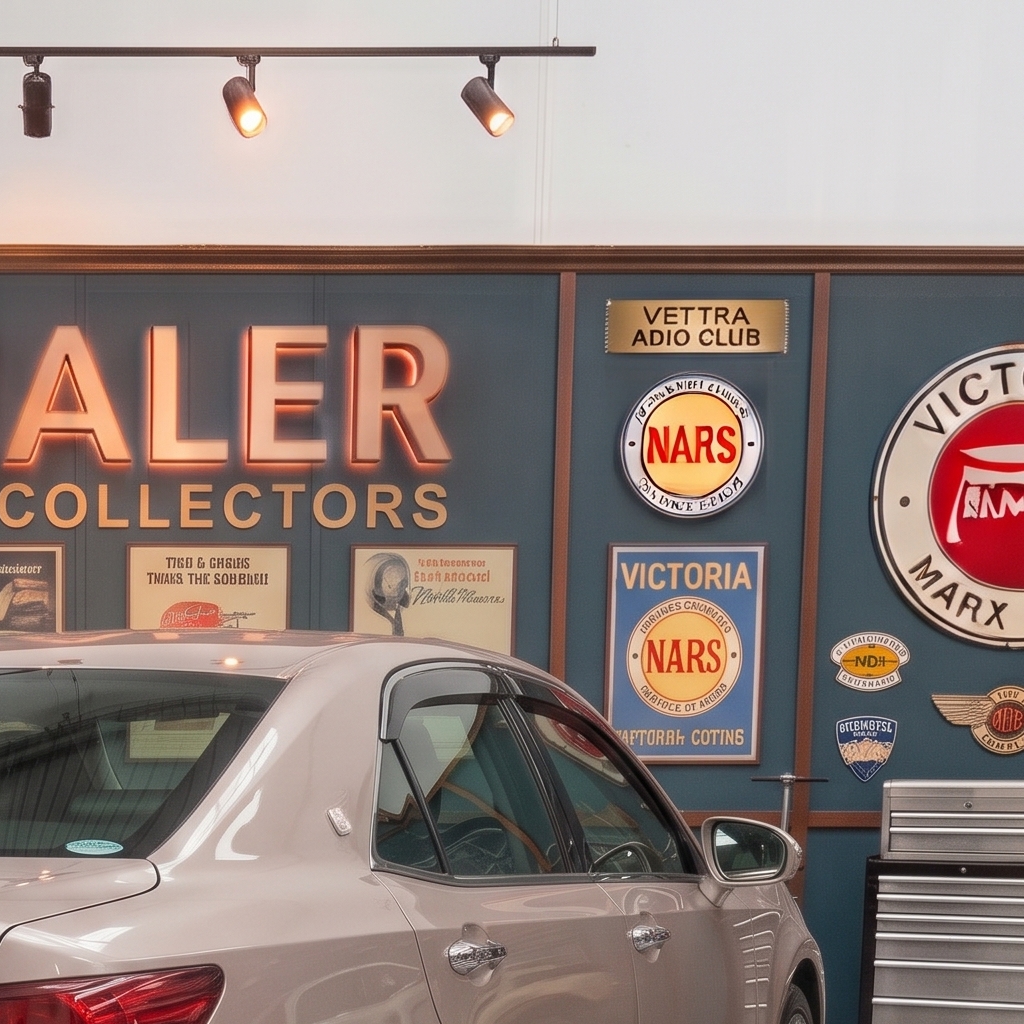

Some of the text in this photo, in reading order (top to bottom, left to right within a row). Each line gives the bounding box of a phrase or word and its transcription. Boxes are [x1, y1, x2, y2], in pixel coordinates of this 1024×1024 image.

[643, 306, 750, 325] VETTRA
[631, 328, 761, 347] ADIO CLUB
[913, 362, 1024, 435] VICT
[647, 425, 737, 464] NARS
[621, 562, 753, 590] VICTORIA
[909, 554, 1009, 631] MARX
[645, 639, 721, 674] NARS
